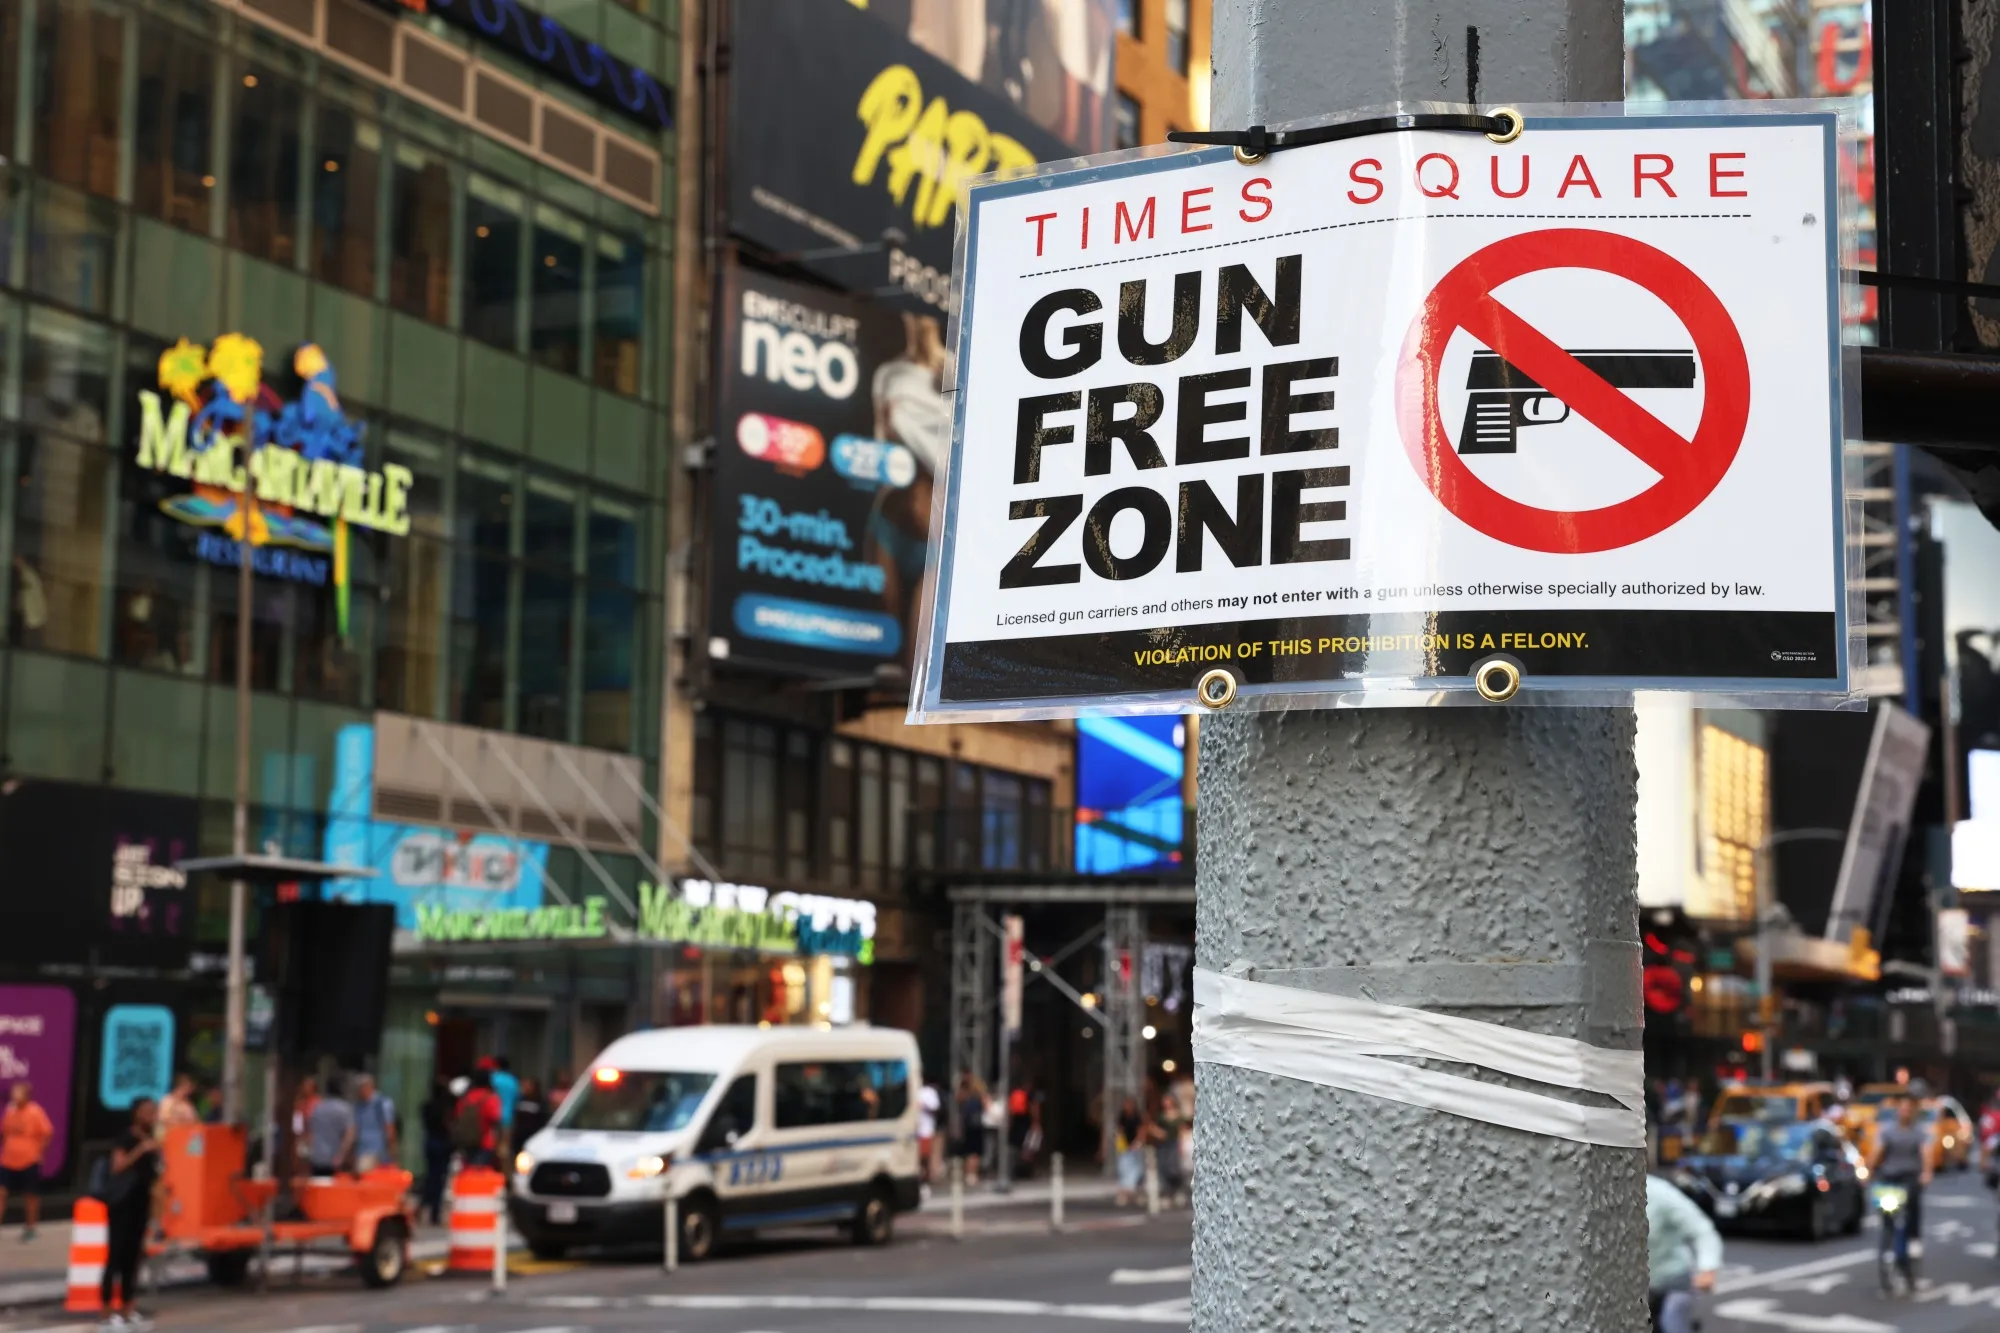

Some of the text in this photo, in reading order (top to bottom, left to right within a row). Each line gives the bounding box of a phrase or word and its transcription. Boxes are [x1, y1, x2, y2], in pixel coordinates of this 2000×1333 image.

[1026, 152, 1748, 256] TIMES SQUARE
[1019, 254, 1302, 379] GUN
[741, 319, 859, 400] neo
[1013, 356, 1339, 485] FREE
[738, 493, 853, 550] 30-min.
[998, 465, 1350, 589] ZONE
[737, 533, 886, 594] Procedure
[996, 581, 1766, 626] Licensed gun carriers and others may not enter with a gun unless otherwise specially authorized by law.
[1134, 632, 1589, 666] VIOLATION OF THIS PROHIBITION IS A FELONY.
